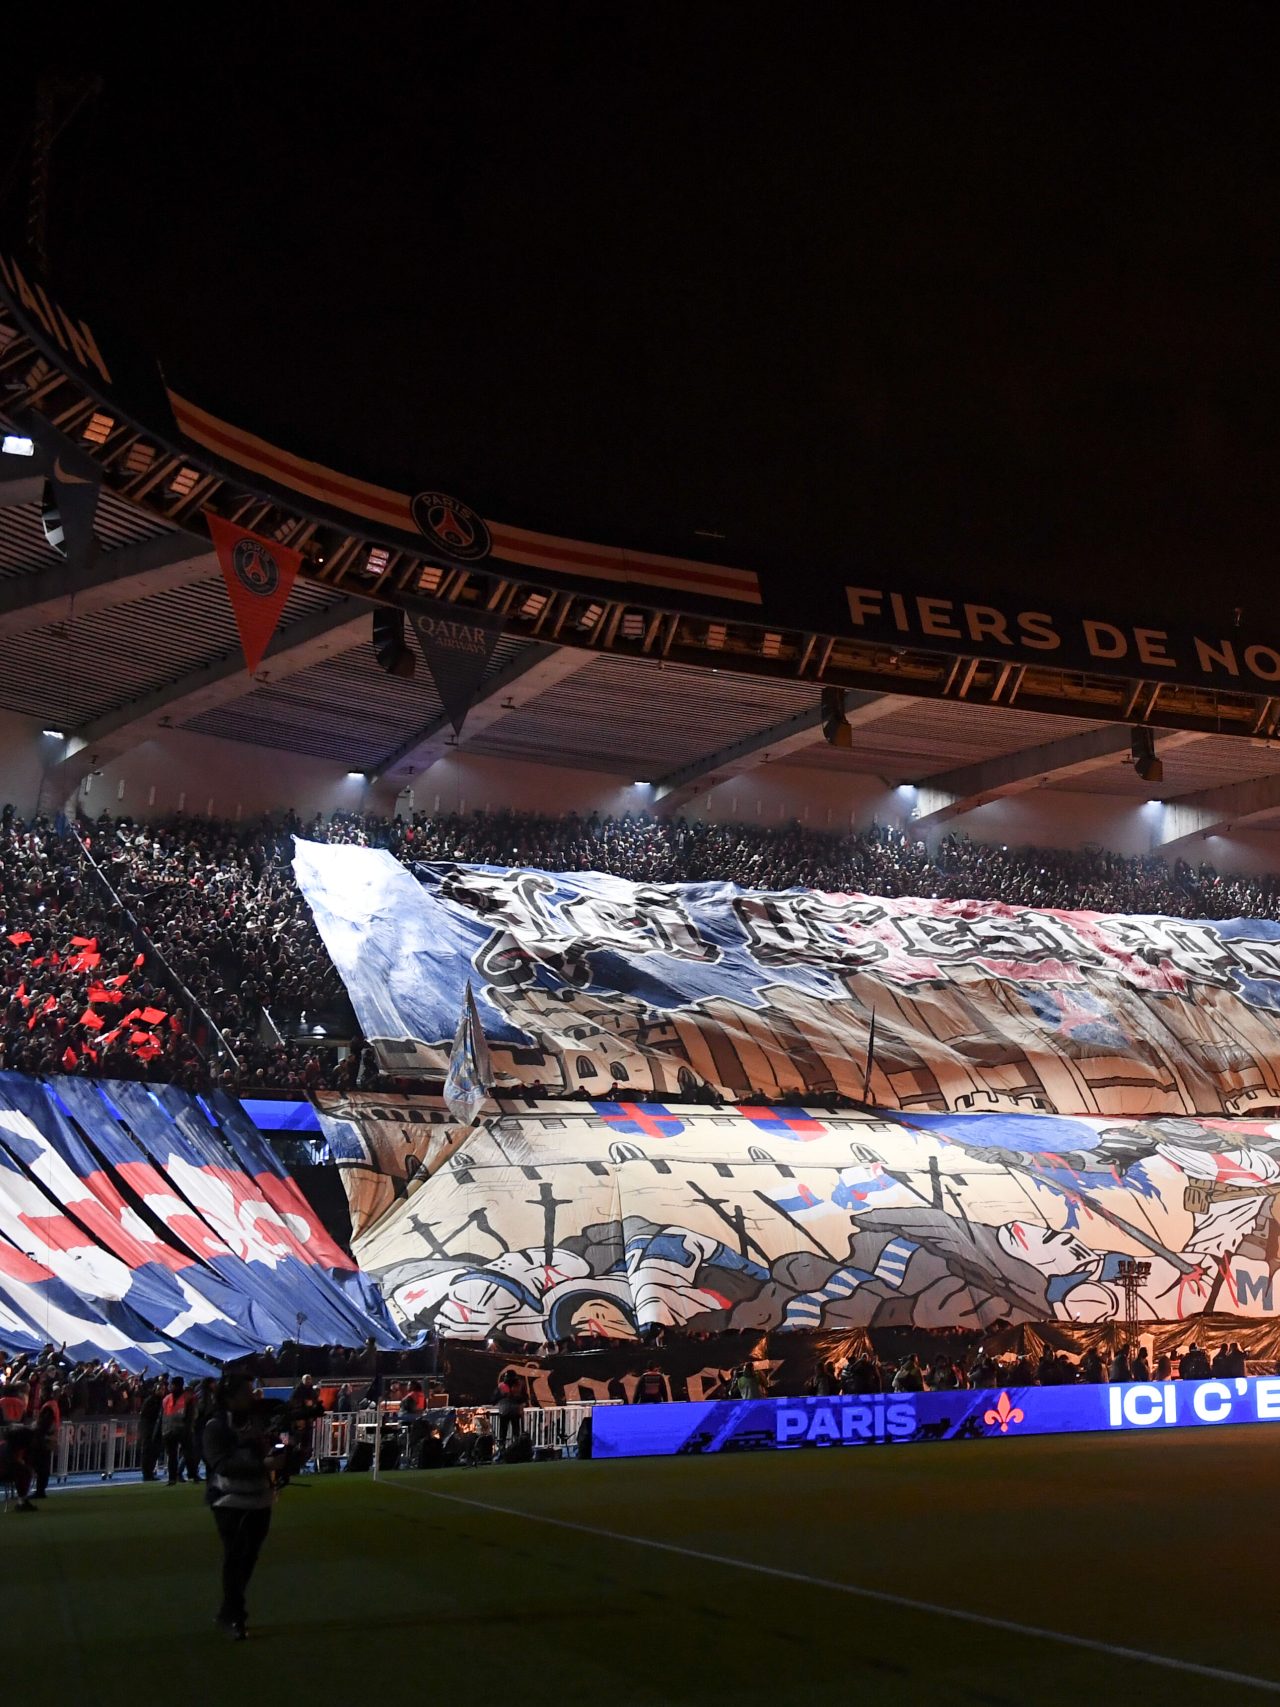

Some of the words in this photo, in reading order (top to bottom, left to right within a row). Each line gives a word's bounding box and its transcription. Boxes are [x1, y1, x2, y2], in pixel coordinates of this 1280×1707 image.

[422, 495, 473, 519] PARIS
[418, 615, 486, 645] QATAR
[845, 585, 1061, 650] FIERS
[1082, 619, 1176, 668] DE
[776, 1404, 917, 1441] PARIS
[1109, 1384, 1175, 1427] ICI
